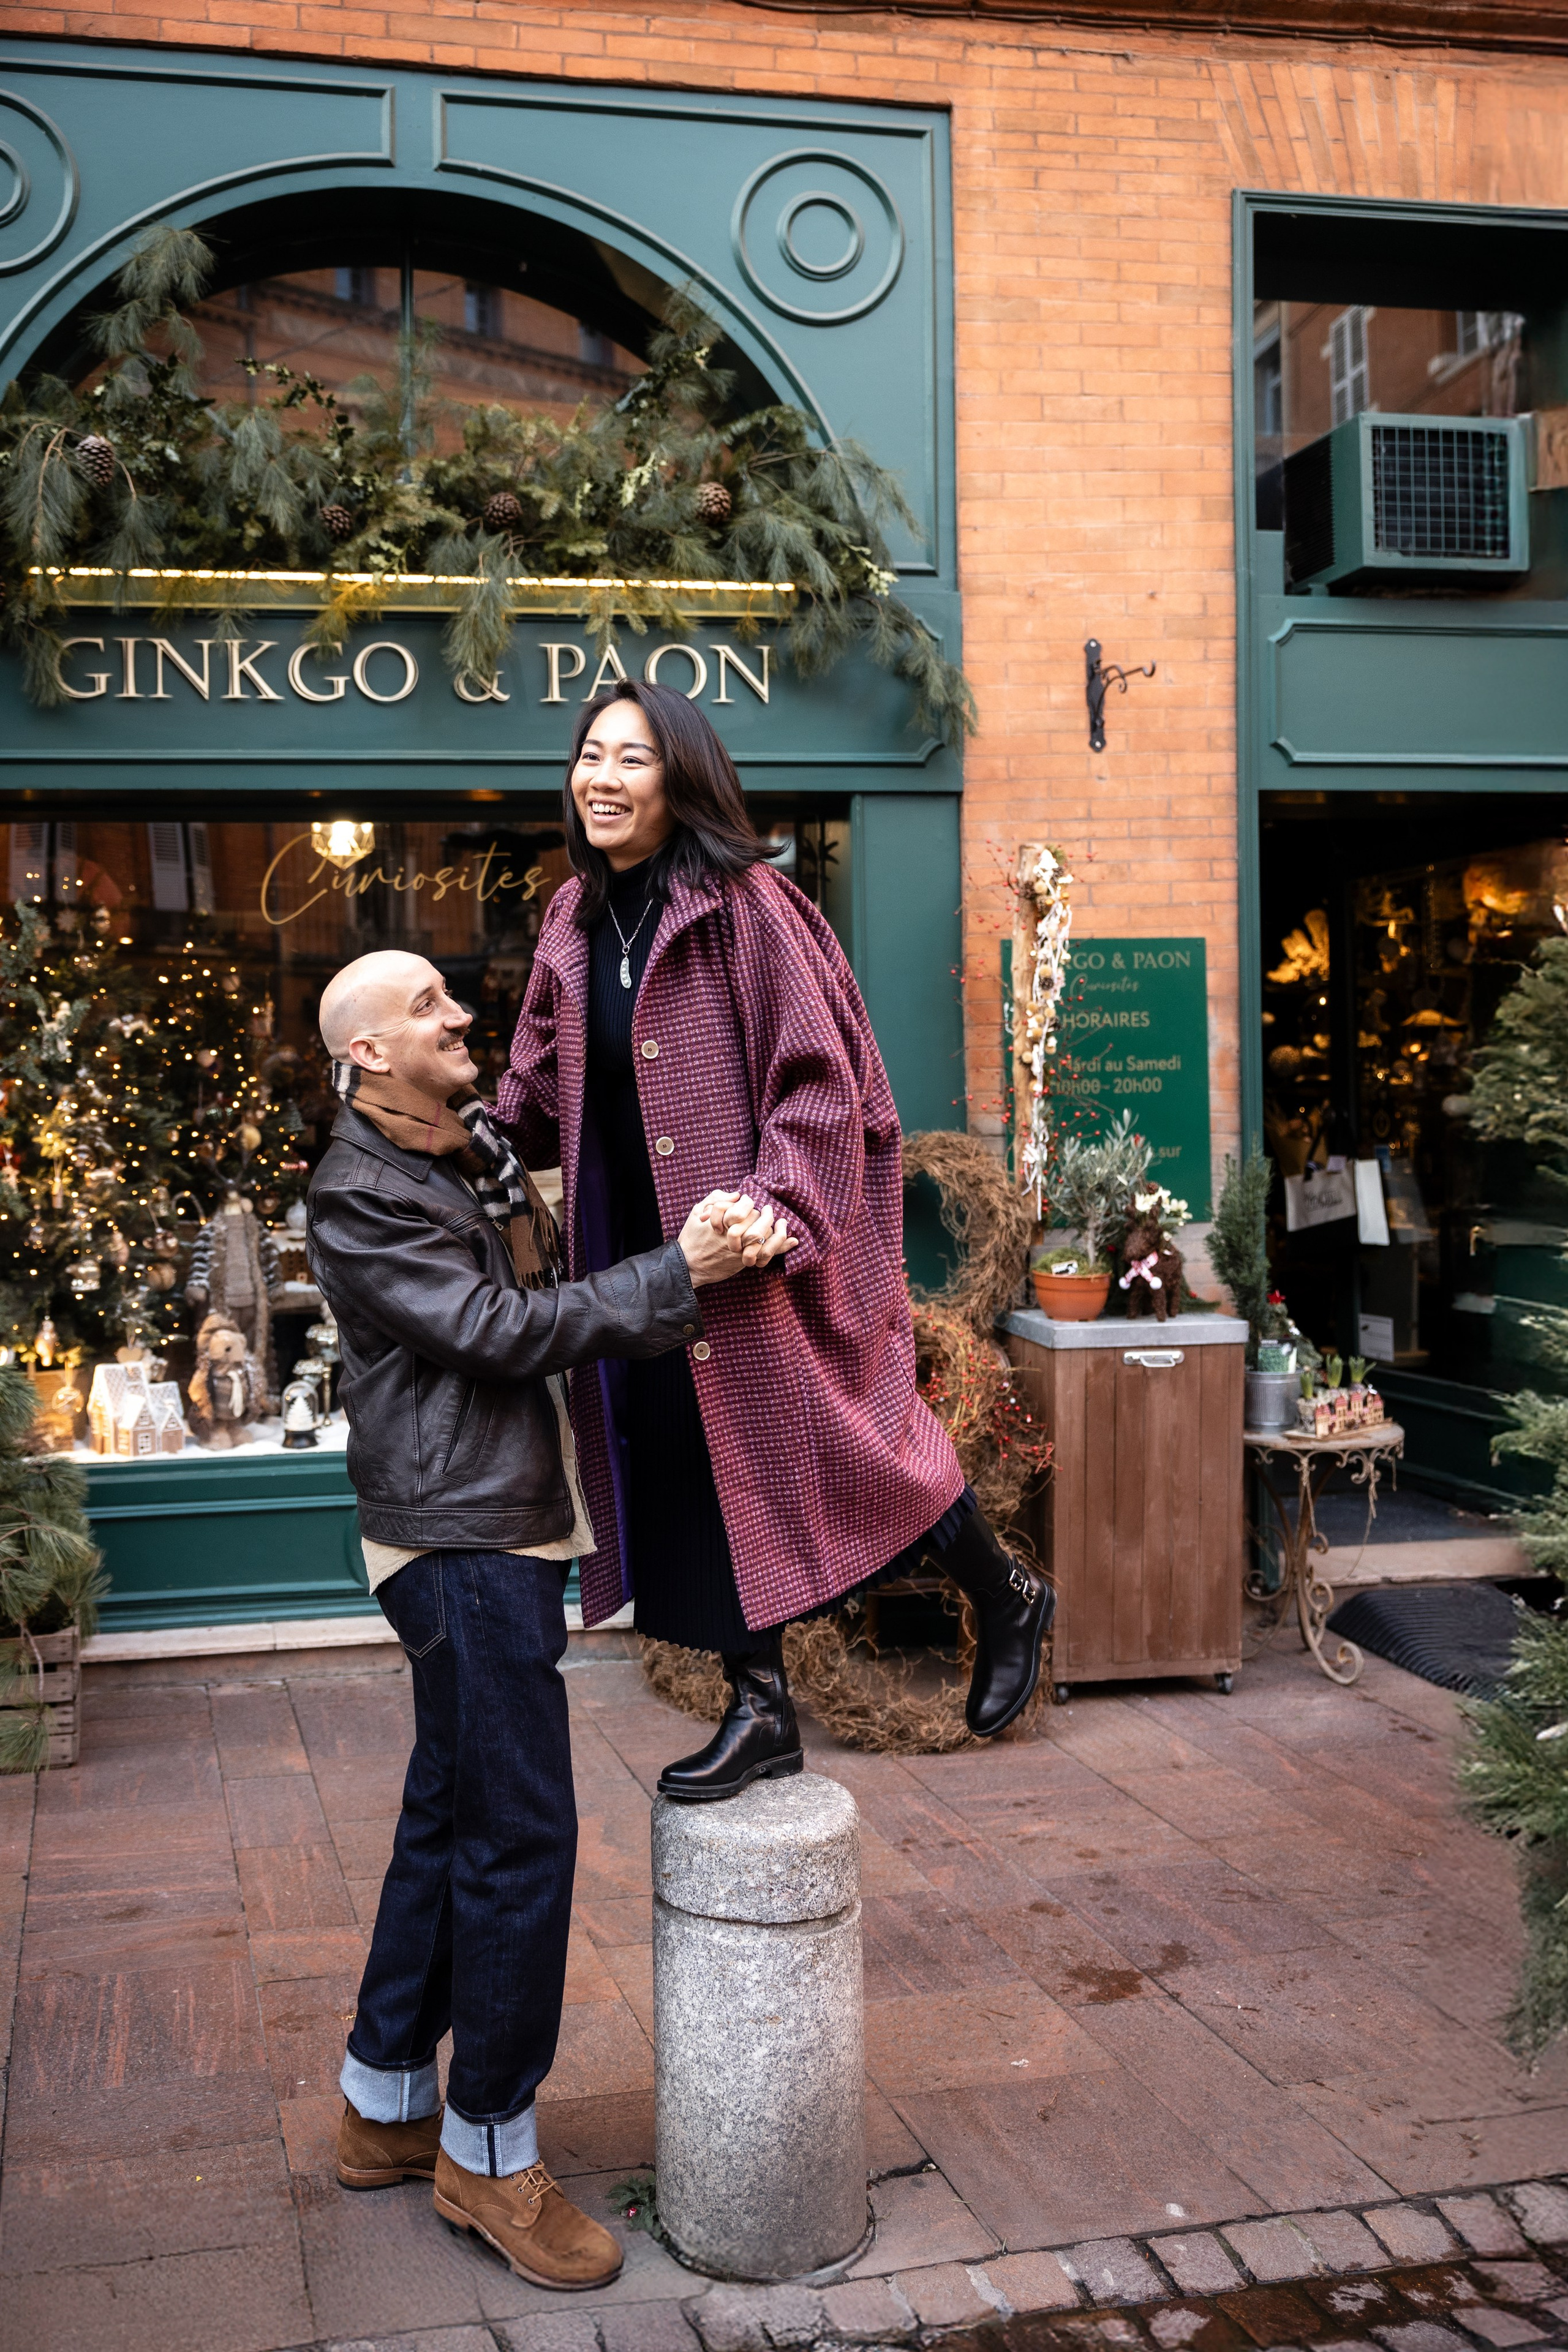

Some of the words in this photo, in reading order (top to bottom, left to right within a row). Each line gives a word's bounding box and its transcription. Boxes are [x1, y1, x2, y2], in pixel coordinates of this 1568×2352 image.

[59, 636, 420, 702] GINKGO
[453, 670, 510, 703] &
[538, 643, 771, 704] PAON
[261, 832, 552, 925] Curiosités
[1112, 951, 1126, 970] &
[1133, 950, 1191, 969] PAON
[1061, 1011, 1150, 1028] HORAIRES
[1105, 1060, 1123, 1072] au
[1126, 1055, 1182, 1071] Samedi
[1113, 1076, 1163, 1094] 20h00
